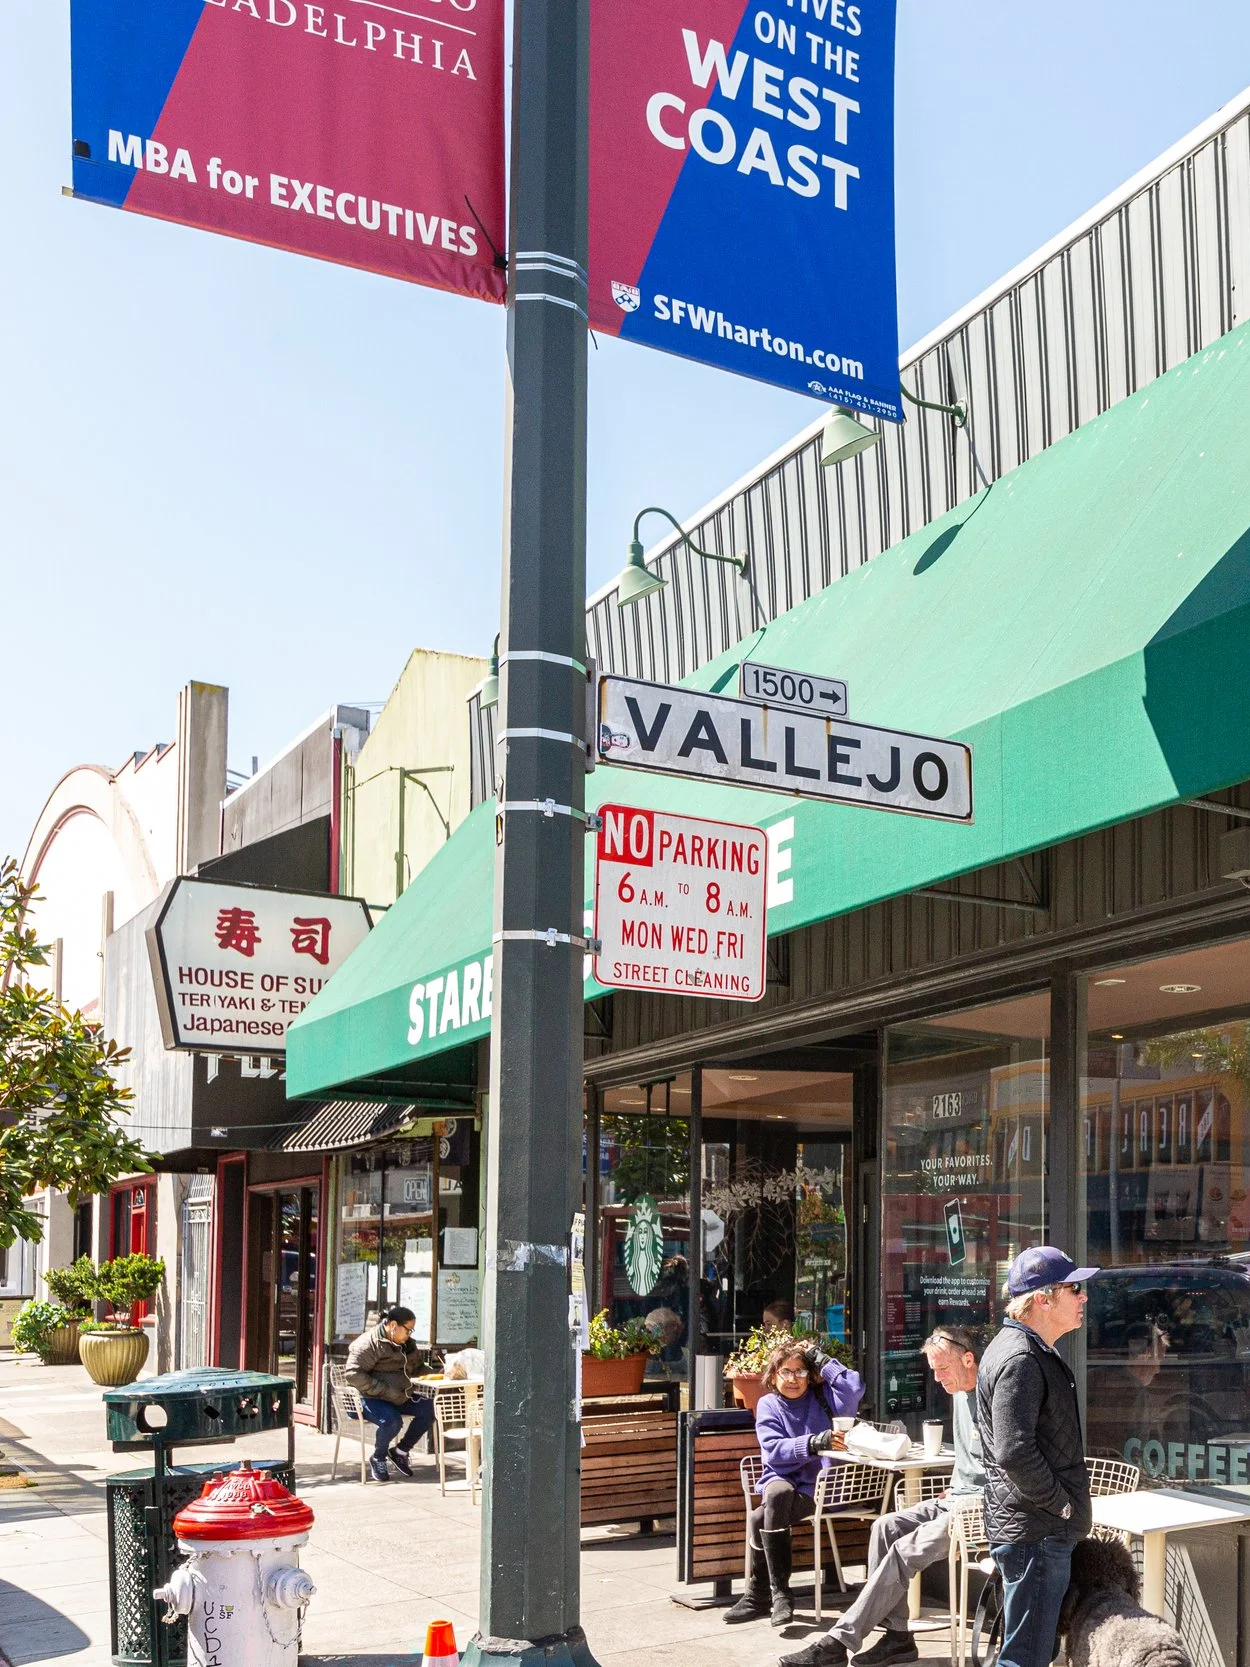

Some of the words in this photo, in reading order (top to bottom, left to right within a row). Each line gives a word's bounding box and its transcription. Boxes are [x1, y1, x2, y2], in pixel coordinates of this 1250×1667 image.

[786, 0, 862, 37] VES
[206, 0, 477, 81] ADELPHIA
[754, 10, 796, 56] ON
[805, 31, 860, 83] THE
[681, 27, 861, 146] WEST
[645, 91, 861, 211] COAST
[107, 128, 197, 184] MBA
[206, 156, 259, 199] for
[269, 172, 479, 256] EXECUTIVES
[653, 294, 865, 380] SFWharton.com
[828, 385, 844, 395] AAA
[844, 390, 862, 400] FLAG
[869, 398, 897, 412] BANNER
[828, 392, 853, 404] (415)
[856, 401, 897, 418] 431-2950
[752, 668, 815, 705] 1500
[624, 695, 949, 801] VALLEJO
[604, 810, 650, 859] NO
[659, 829, 760, 876] PARKING
[617, 871, 635, 904] 6
[639, 889, 669, 908] A.M.
[677, 882, 690, 895] TO
[705, 881, 721, 914] 8
[726, 900, 753, 919] A.M.
[621, 919, 663, 950] MON
[671, 925, 709, 955] WED
[717, 931, 744, 960] FRI
[178, 966, 254, 990] HOUSE
[260, 974, 289, 993] OF
[294, 976, 329, 995] SU
[613, 961, 669, 983] STREET
[674, 968, 750, 992] CLEANING
[260, 998, 276, 1012] &
[183, 1013, 284, 1036] Japanese
[934, 1093, 960, 1117] 2163
[920, 1157, 942, 1170] YOUR
[945, 1154, 993, 1168] FAVORITES.
[405, 1180, 428, 1200] OPEN
[933, 1174, 955, 1187] YOUR
[958, 1173, 979, 1186] WAY.
[920, 1276, 942, 1285] Download
[943, 1276, 951, 1285] the
[951, 1278, 960, 1287] app
[960, 1277, 966, 1285] to
[923, 1288, 934, 1297] your
[948, 1287, 961, 1296] order
[961, 1287, 976, 1296] ahead
[976, 1287, 987, 1297] and
[1123, 1437, 1248, 1485] COFFEE
[219, 1611, 234, 1620] SF
